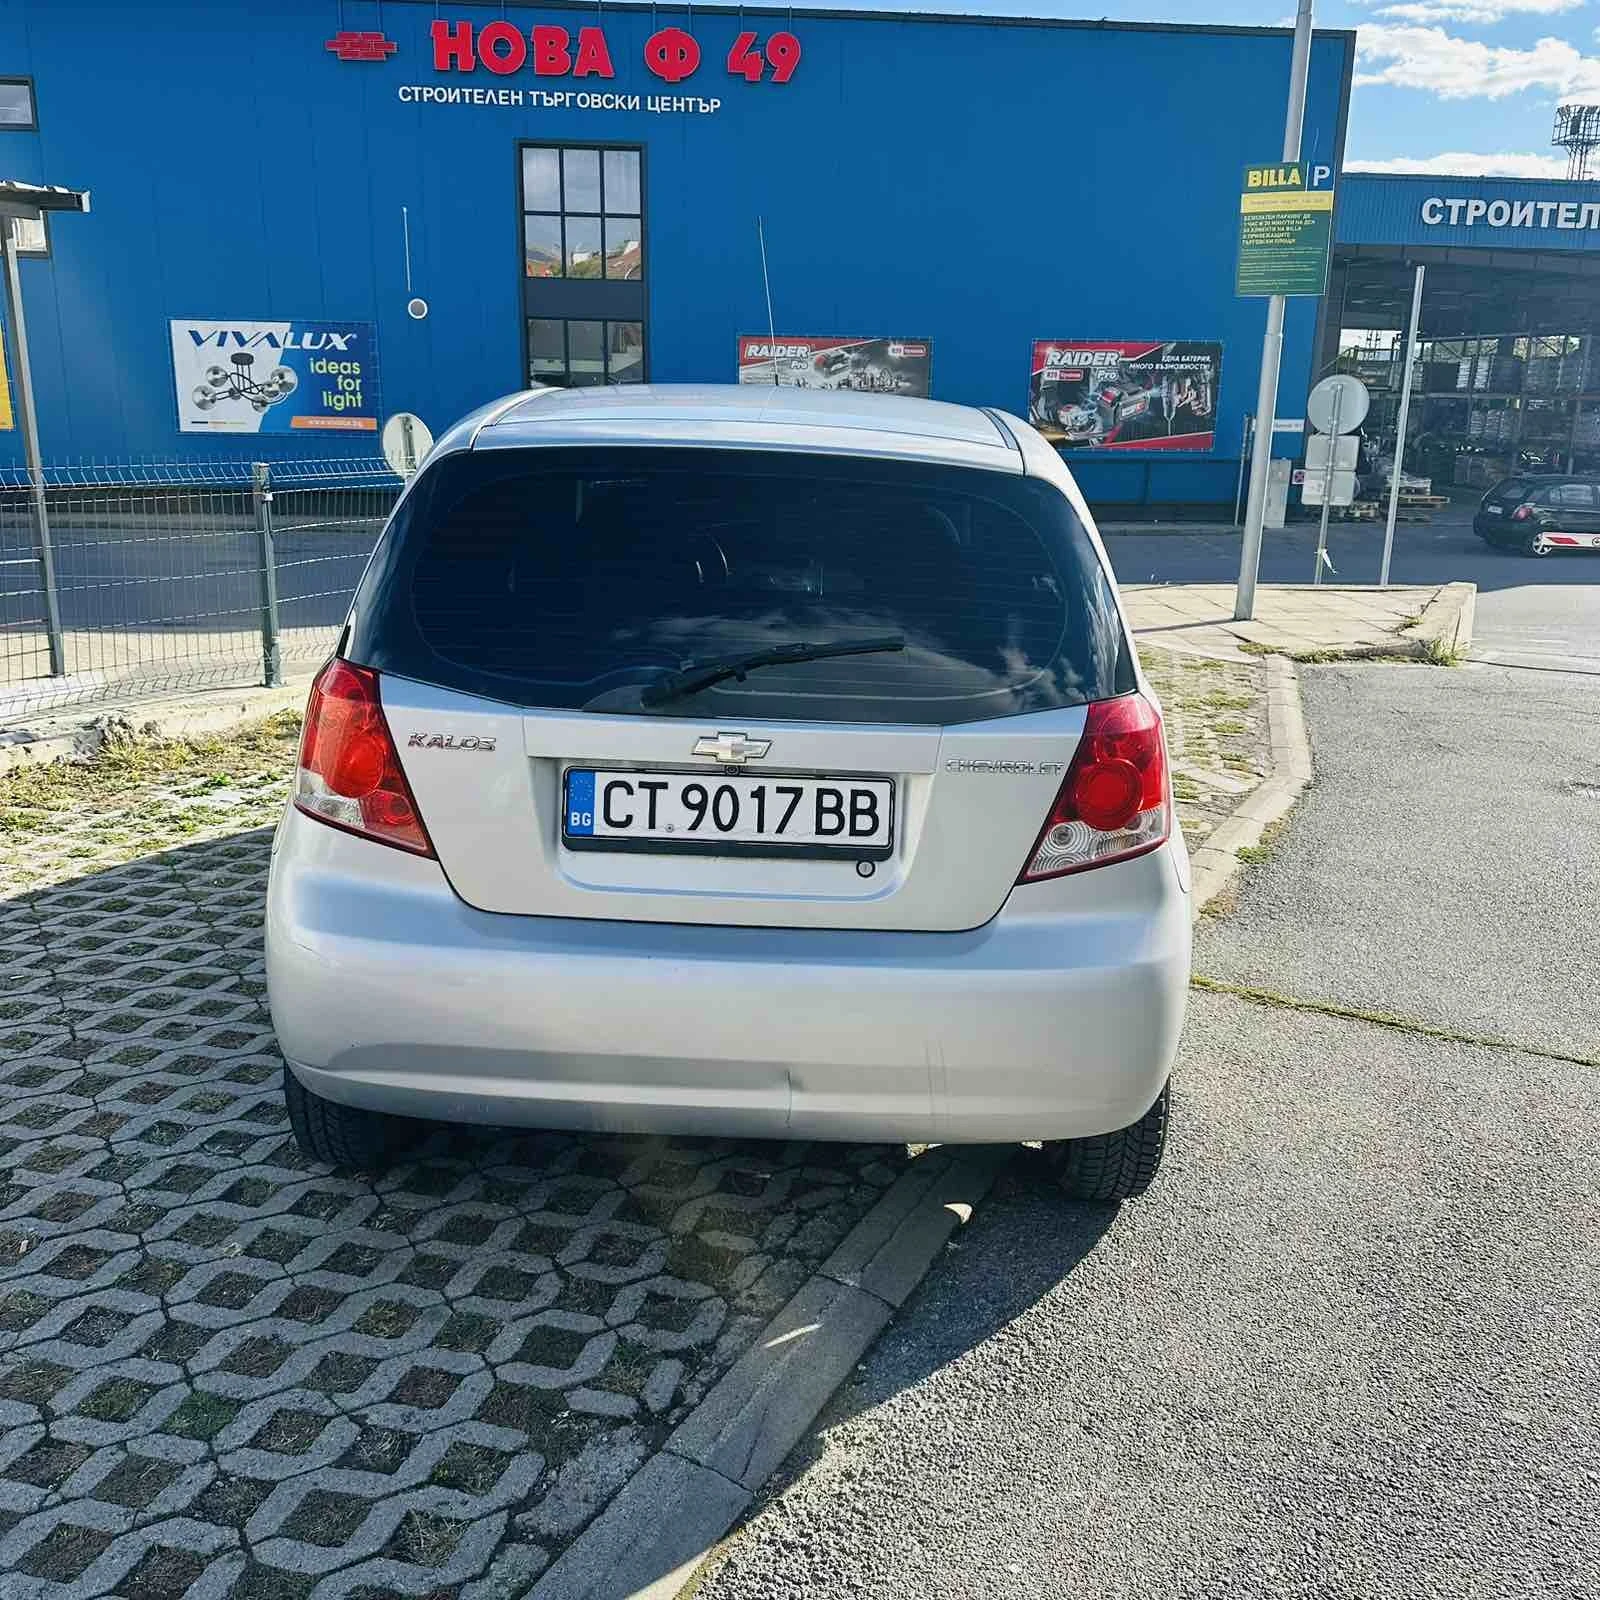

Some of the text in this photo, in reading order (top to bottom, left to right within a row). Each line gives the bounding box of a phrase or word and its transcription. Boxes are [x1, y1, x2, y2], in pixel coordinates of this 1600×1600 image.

[431, 20, 801, 82] НОВА Ф 49
[398, 86, 721, 113] СТРОИТЕЛЕН ТЪРГОВСКИ ЦЕНТЪР
[1247, 166, 1330, 187] BILLA P
[1422, 197, 1600, 229] СТРОИТЕЛ
[188, 330, 353, 350] VIVALUX
[747, 344, 809, 358] RAIDER
[1046, 351, 1119, 366] RAIDER
[309, 358, 361, 374] ideas
[790, 360, 808, 370] Pro
[1097, 370, 1116, 380] Pro
[337, 375, 361, 390] for
[322, 391, 362, 411] light
[408, 732, 496, 752] KALOS
[603, 780, 880, 837] CT 9017 BB
[571, 812, 592, 827] BG
